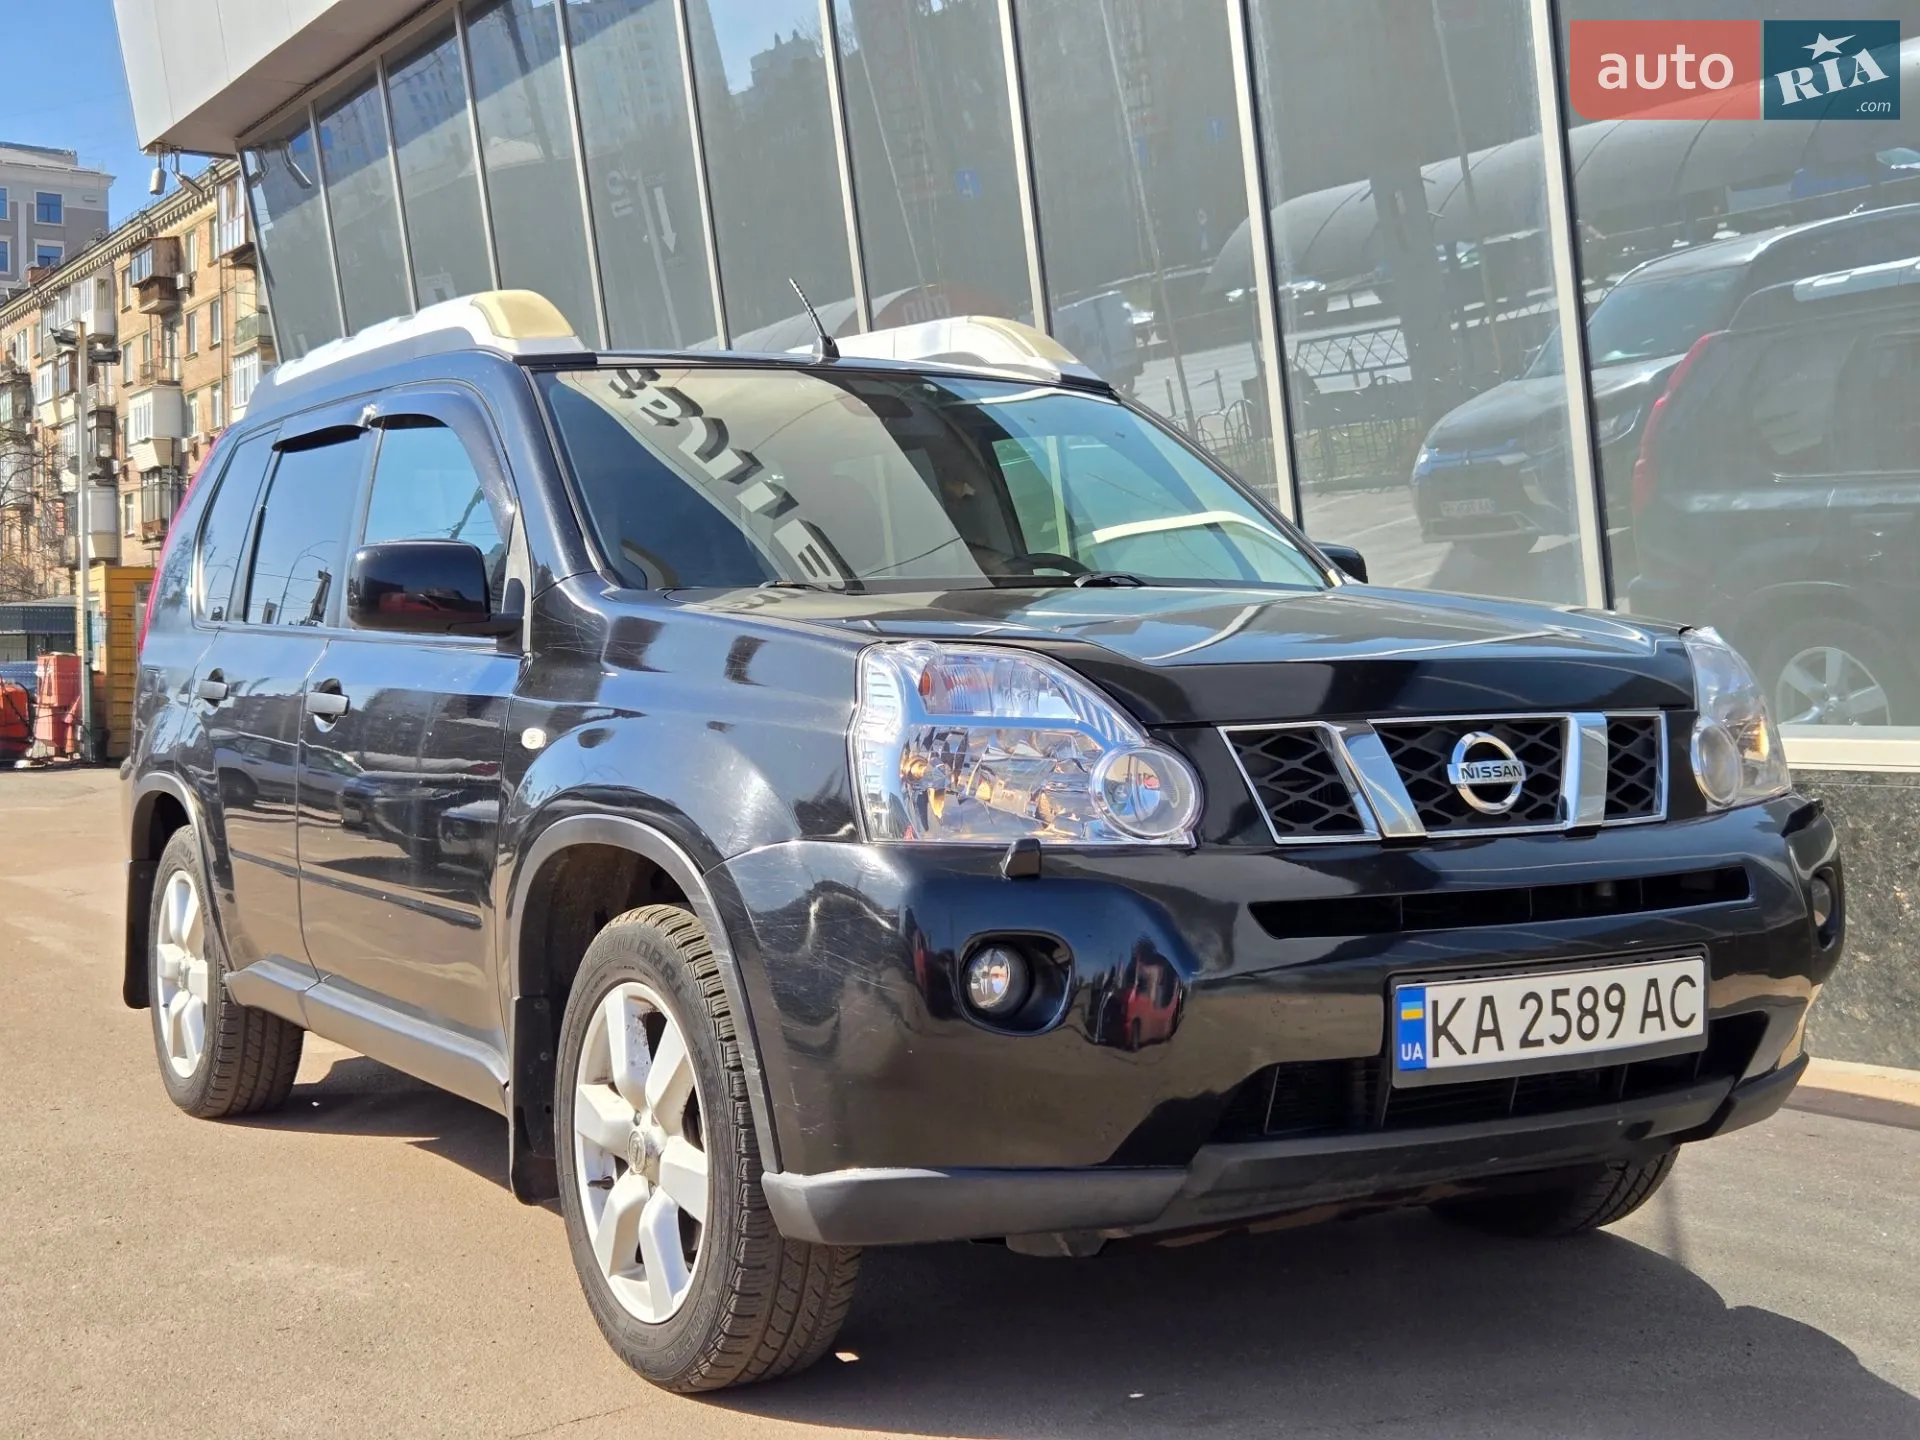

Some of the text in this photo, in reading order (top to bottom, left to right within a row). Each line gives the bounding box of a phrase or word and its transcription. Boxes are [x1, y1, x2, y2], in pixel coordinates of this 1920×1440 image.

[1461, 765, 1522, 780] NISSAN
[1431, 974, 1697, 1058] KA 2589 AC
[1401, 1042, 1424, 1061] UA
